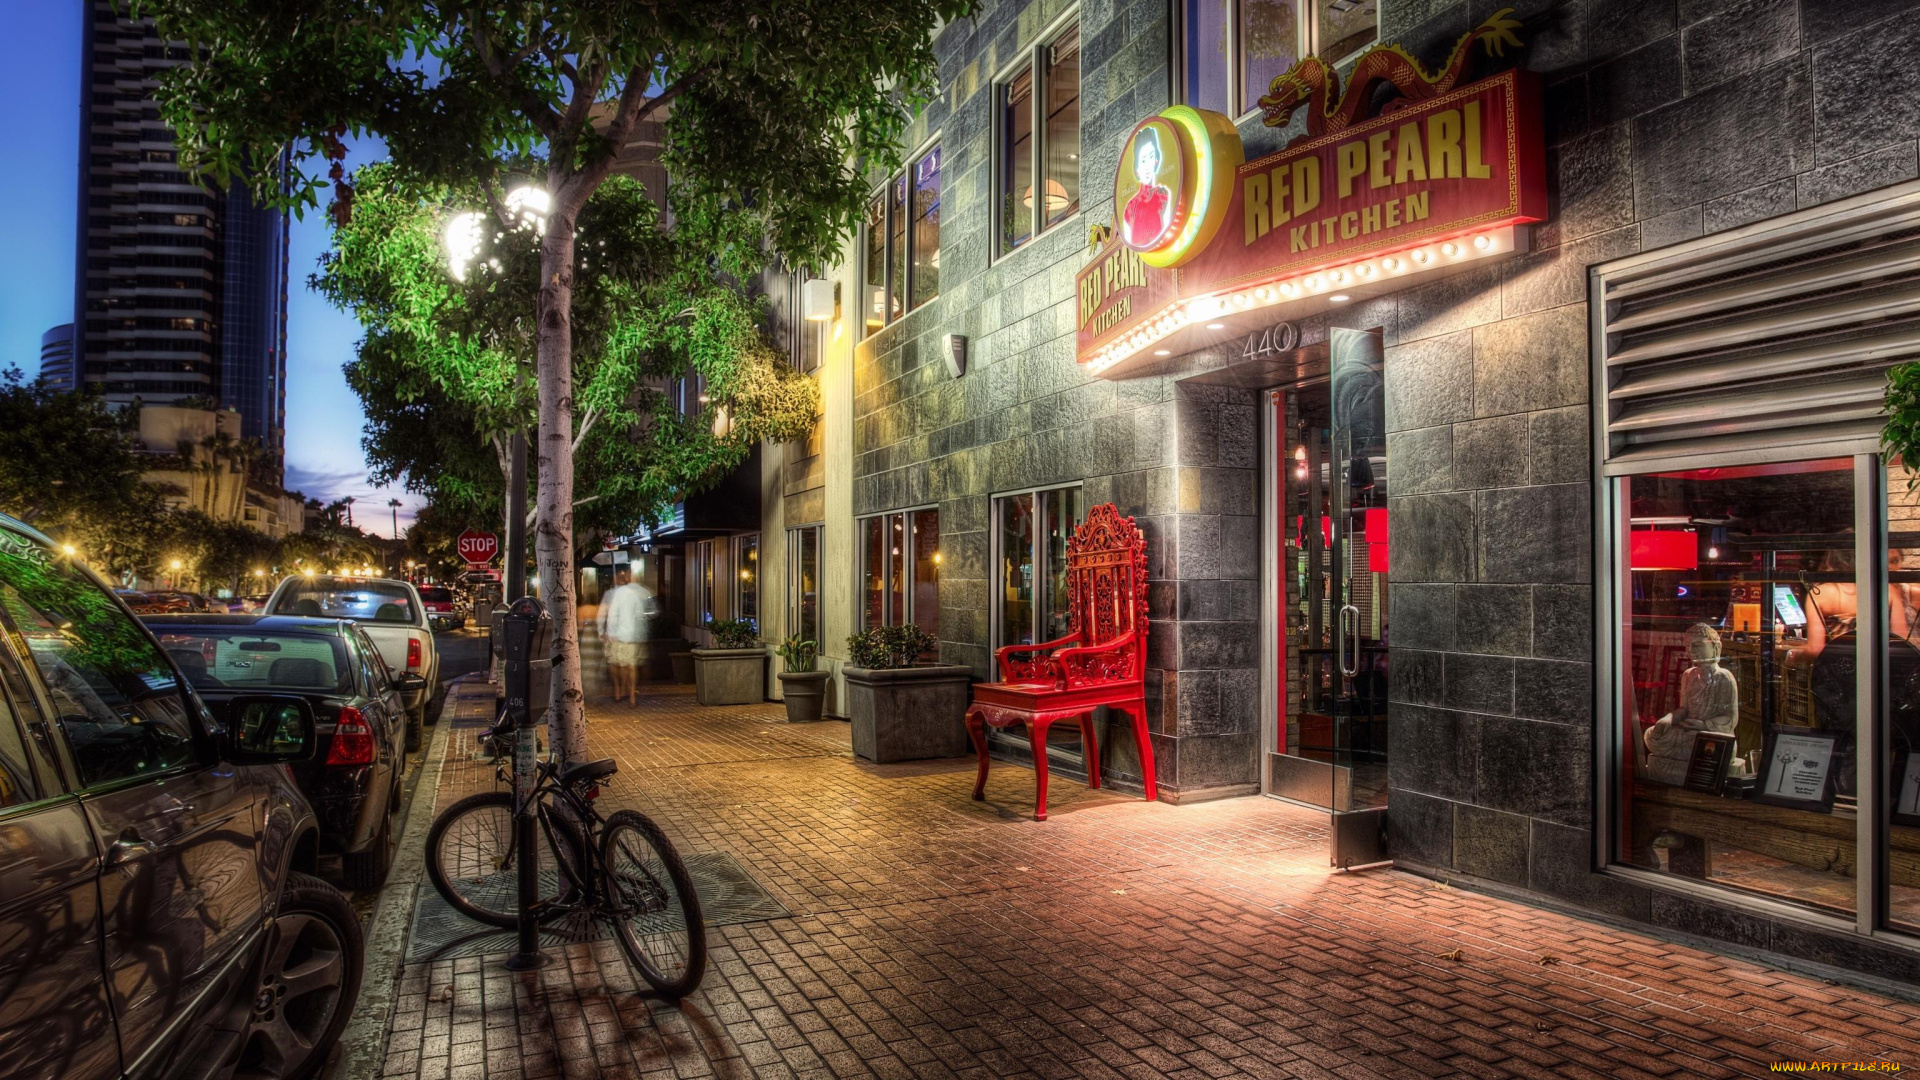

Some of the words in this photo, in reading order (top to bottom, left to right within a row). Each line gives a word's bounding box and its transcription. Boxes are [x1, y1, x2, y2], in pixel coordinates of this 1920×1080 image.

[1244, 155, 1320, 247] RED
[1337, 100, 1491, 199] PEARL
[1290, 190, 1430, 254] KITCHEN
[1080, 267, 1102, 332] RED
[1105, 246, 1148, 299] PEARL
[1092, 294, 1132, 338] KITCHEN
[1242, 322, 1292, 360] 440
[461, 538, 495, 552] STOP
[509, 697, 524, 707] 406
